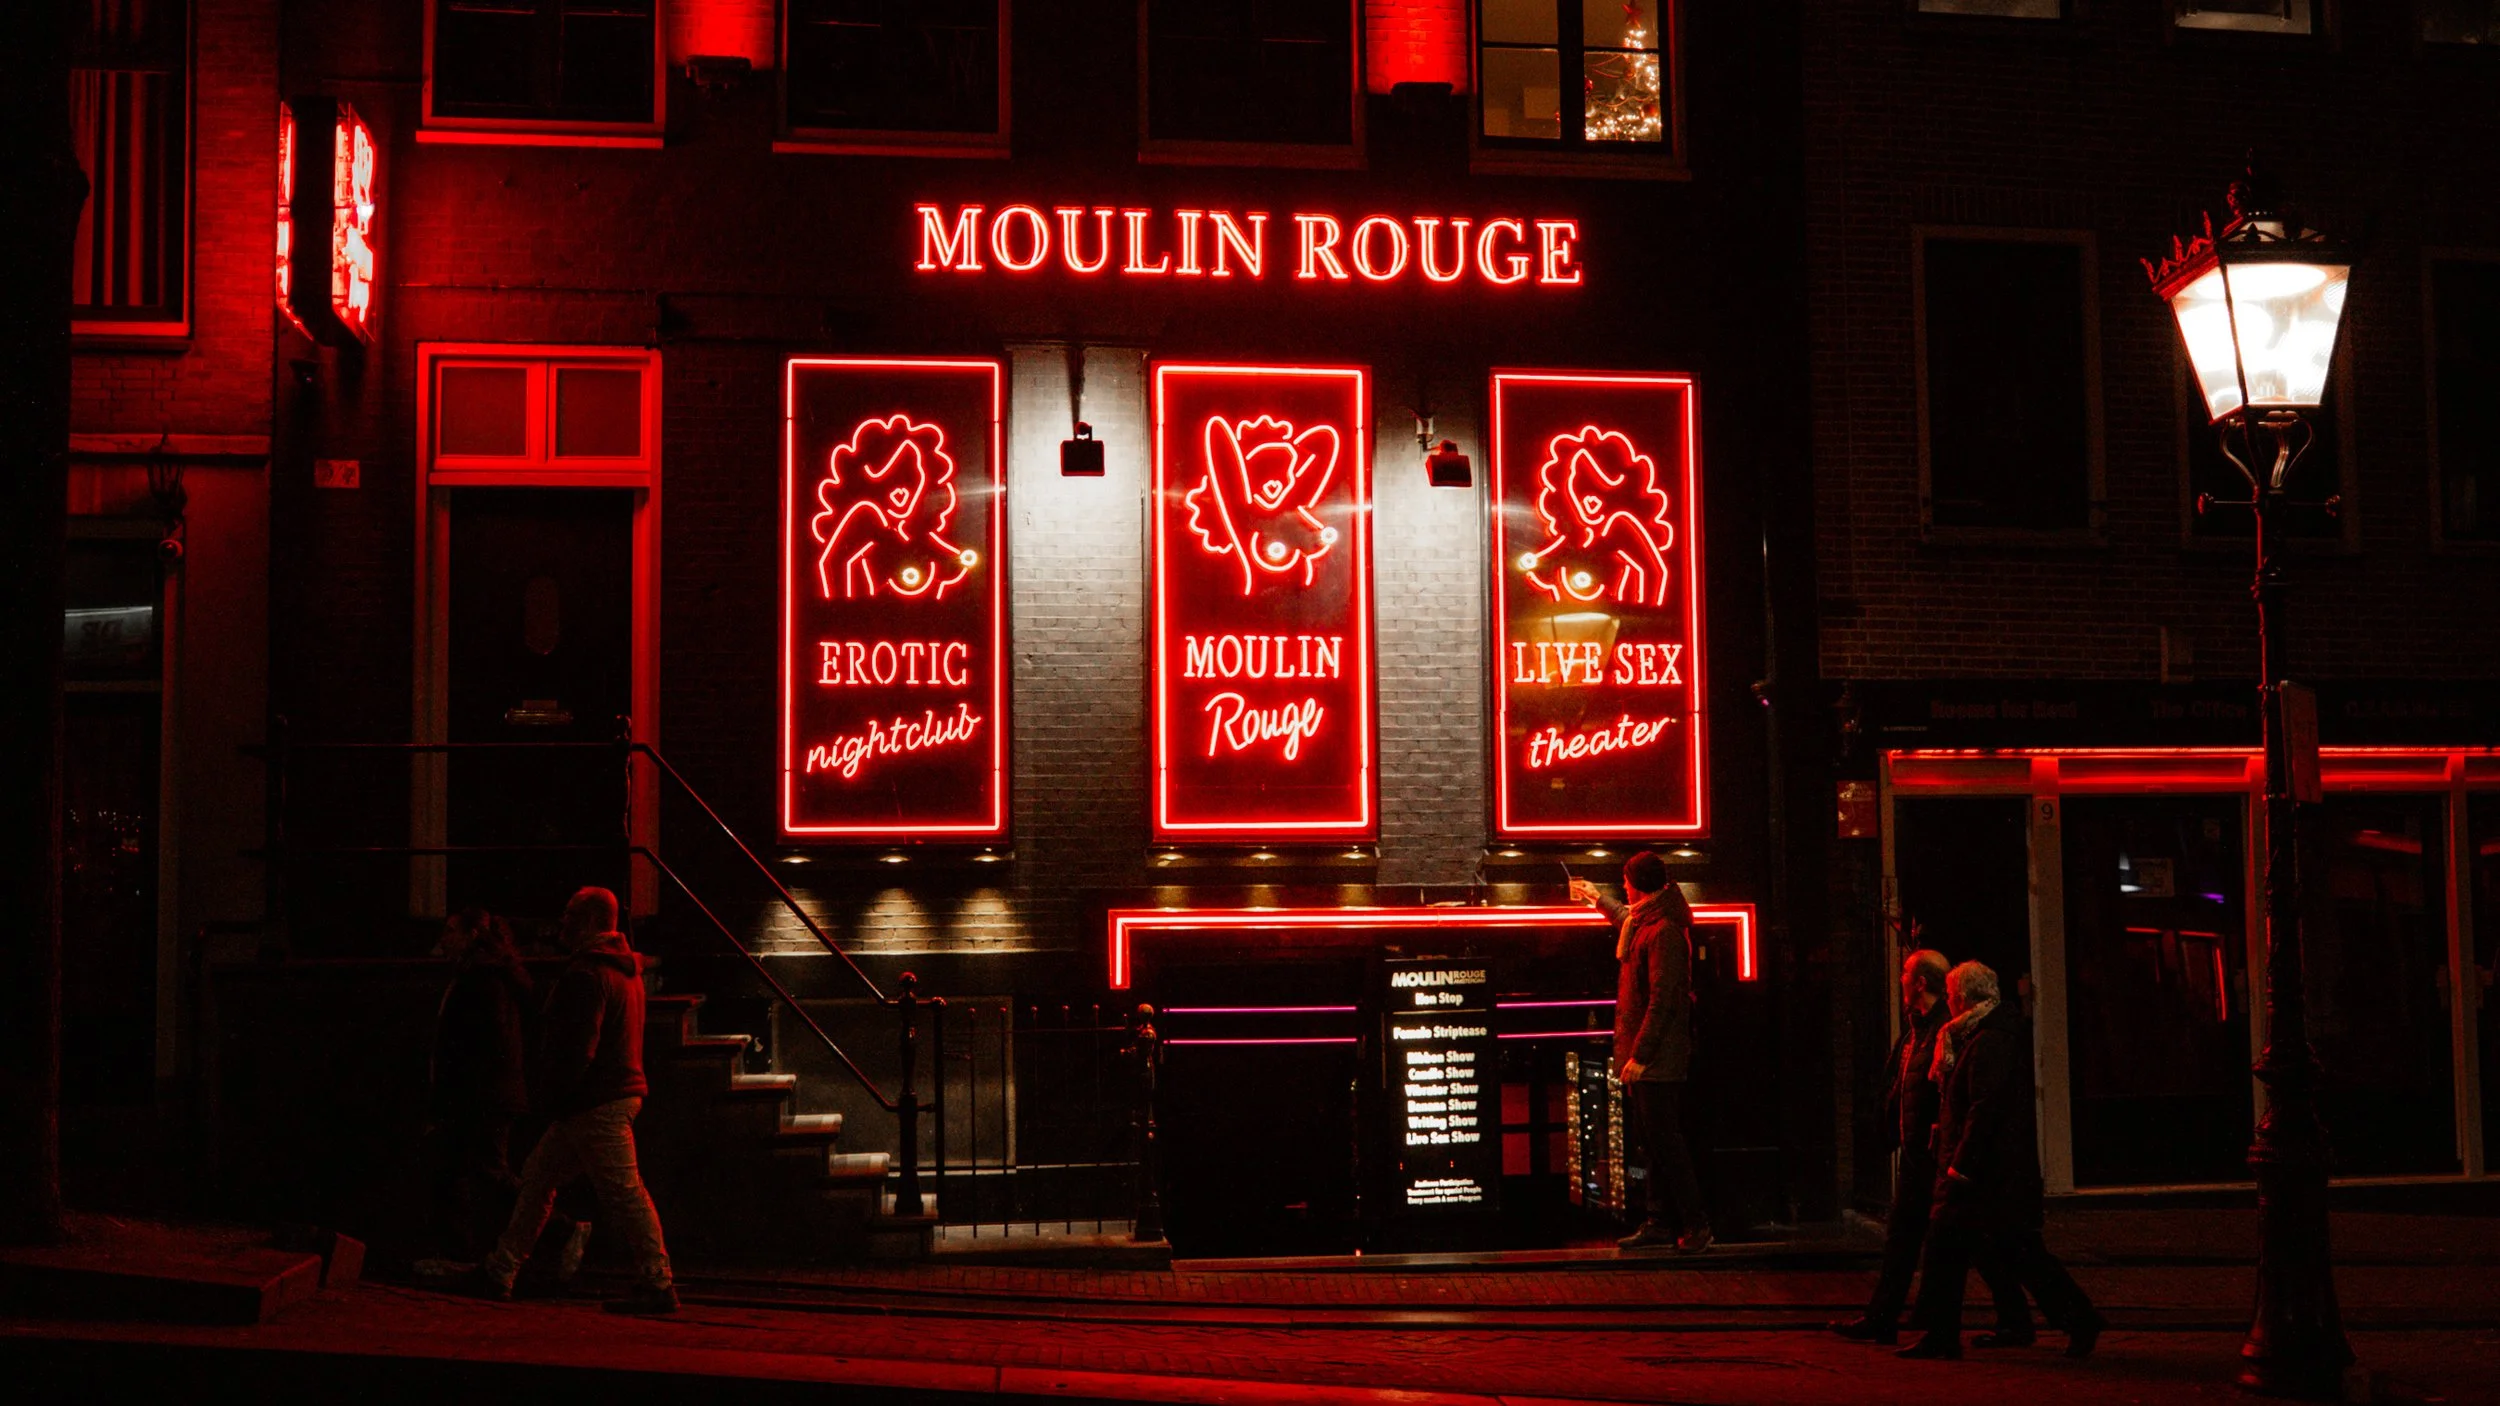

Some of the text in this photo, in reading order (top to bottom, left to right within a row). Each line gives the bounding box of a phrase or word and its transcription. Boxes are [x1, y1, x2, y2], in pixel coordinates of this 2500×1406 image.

[917, 205, 1580, 285] MOULIN ROUGE
[819, 640, 967, 686] EROTIC
[1184, 634, 1343, 679] MOULIN
[1512, 642, 1683, 686] LIVE SEX
[1205, 692, 1324, 761] Rouge
[806, 703, 981, 778] nightclub
[1528, 714, 1677, 769] theater
[2041, 802, 2054, 821] 9
[1391, 970, 1486, 987] MOULIN ROUGE
[1438, 991, 1464, 1006] Stop
[1433, 1025, 1487, 1040] Striptease
[1445, 1050, 1475, 1063] Show
[1445, 1066, 1475, 1079] Show
[1450, 1082, 1479, 1095] Show
[1448, 1098, 1477, 1111] Show
[1448, 1114, 1478, 1127] Show
[1406, 1130, 1480, 1145] Live Sex Show
